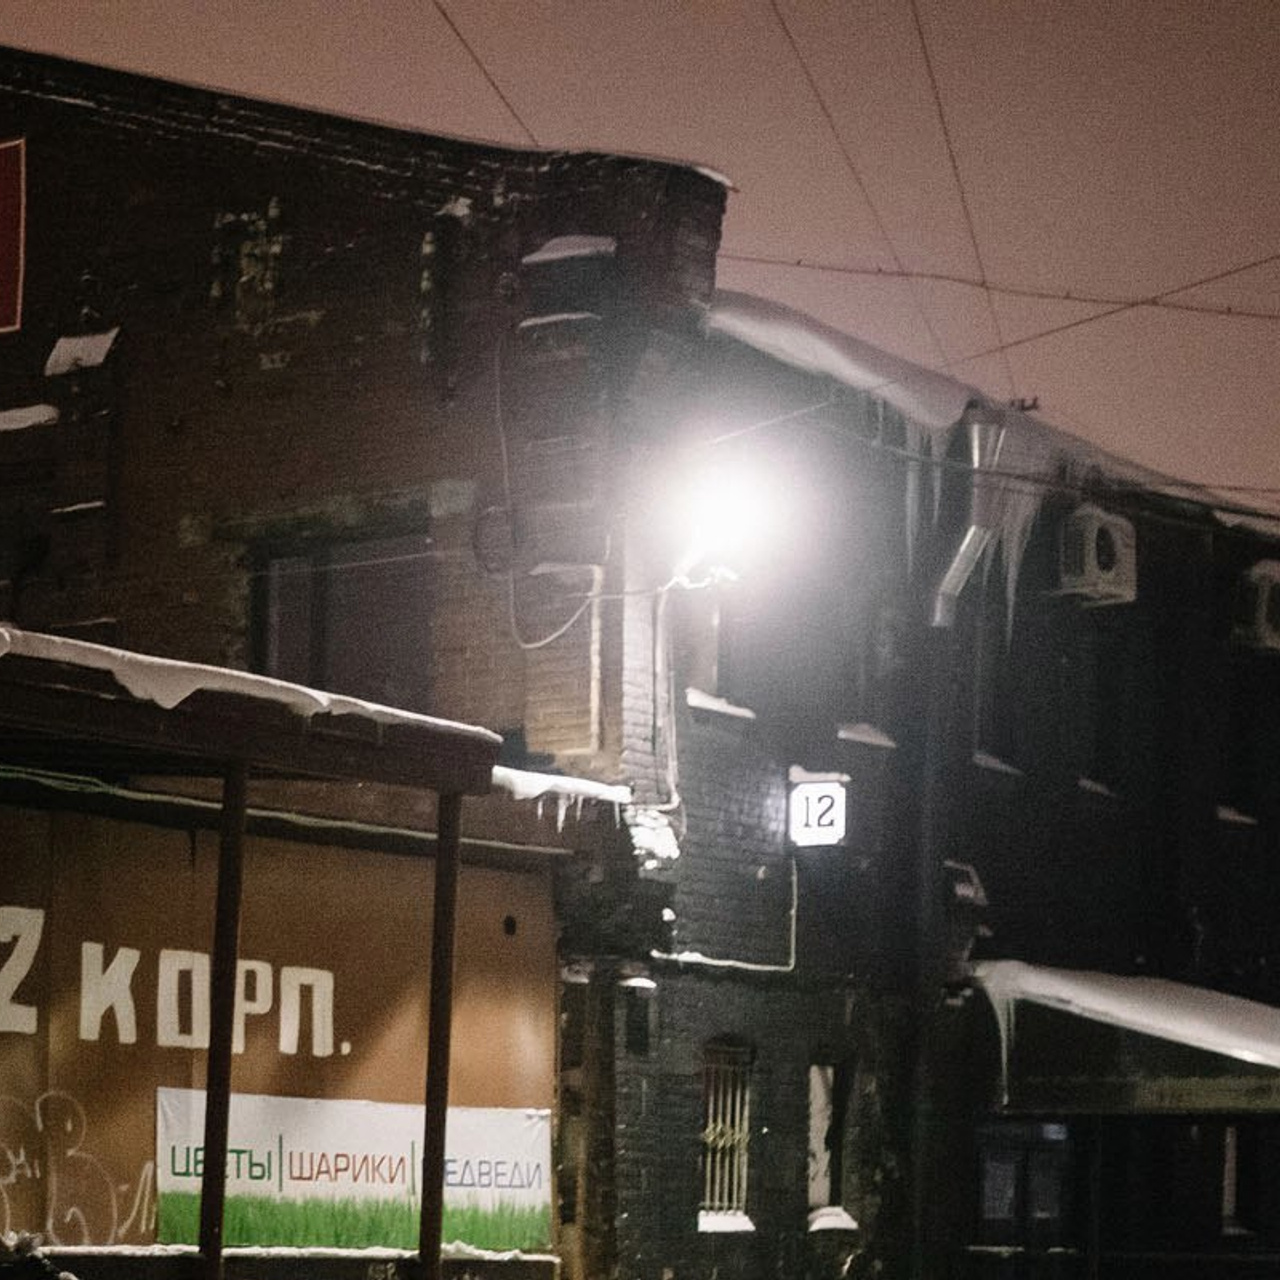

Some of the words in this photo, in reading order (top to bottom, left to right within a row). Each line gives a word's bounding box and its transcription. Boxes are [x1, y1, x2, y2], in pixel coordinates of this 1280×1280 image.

[803, 794, 835, 828] 12
[171, 1144, 273, 1181] ЦВТЫ
[288, 1150, 406, 1184] ШАРИКИ
[442, 1158, 543, 1190] ЕДВЕДИ
